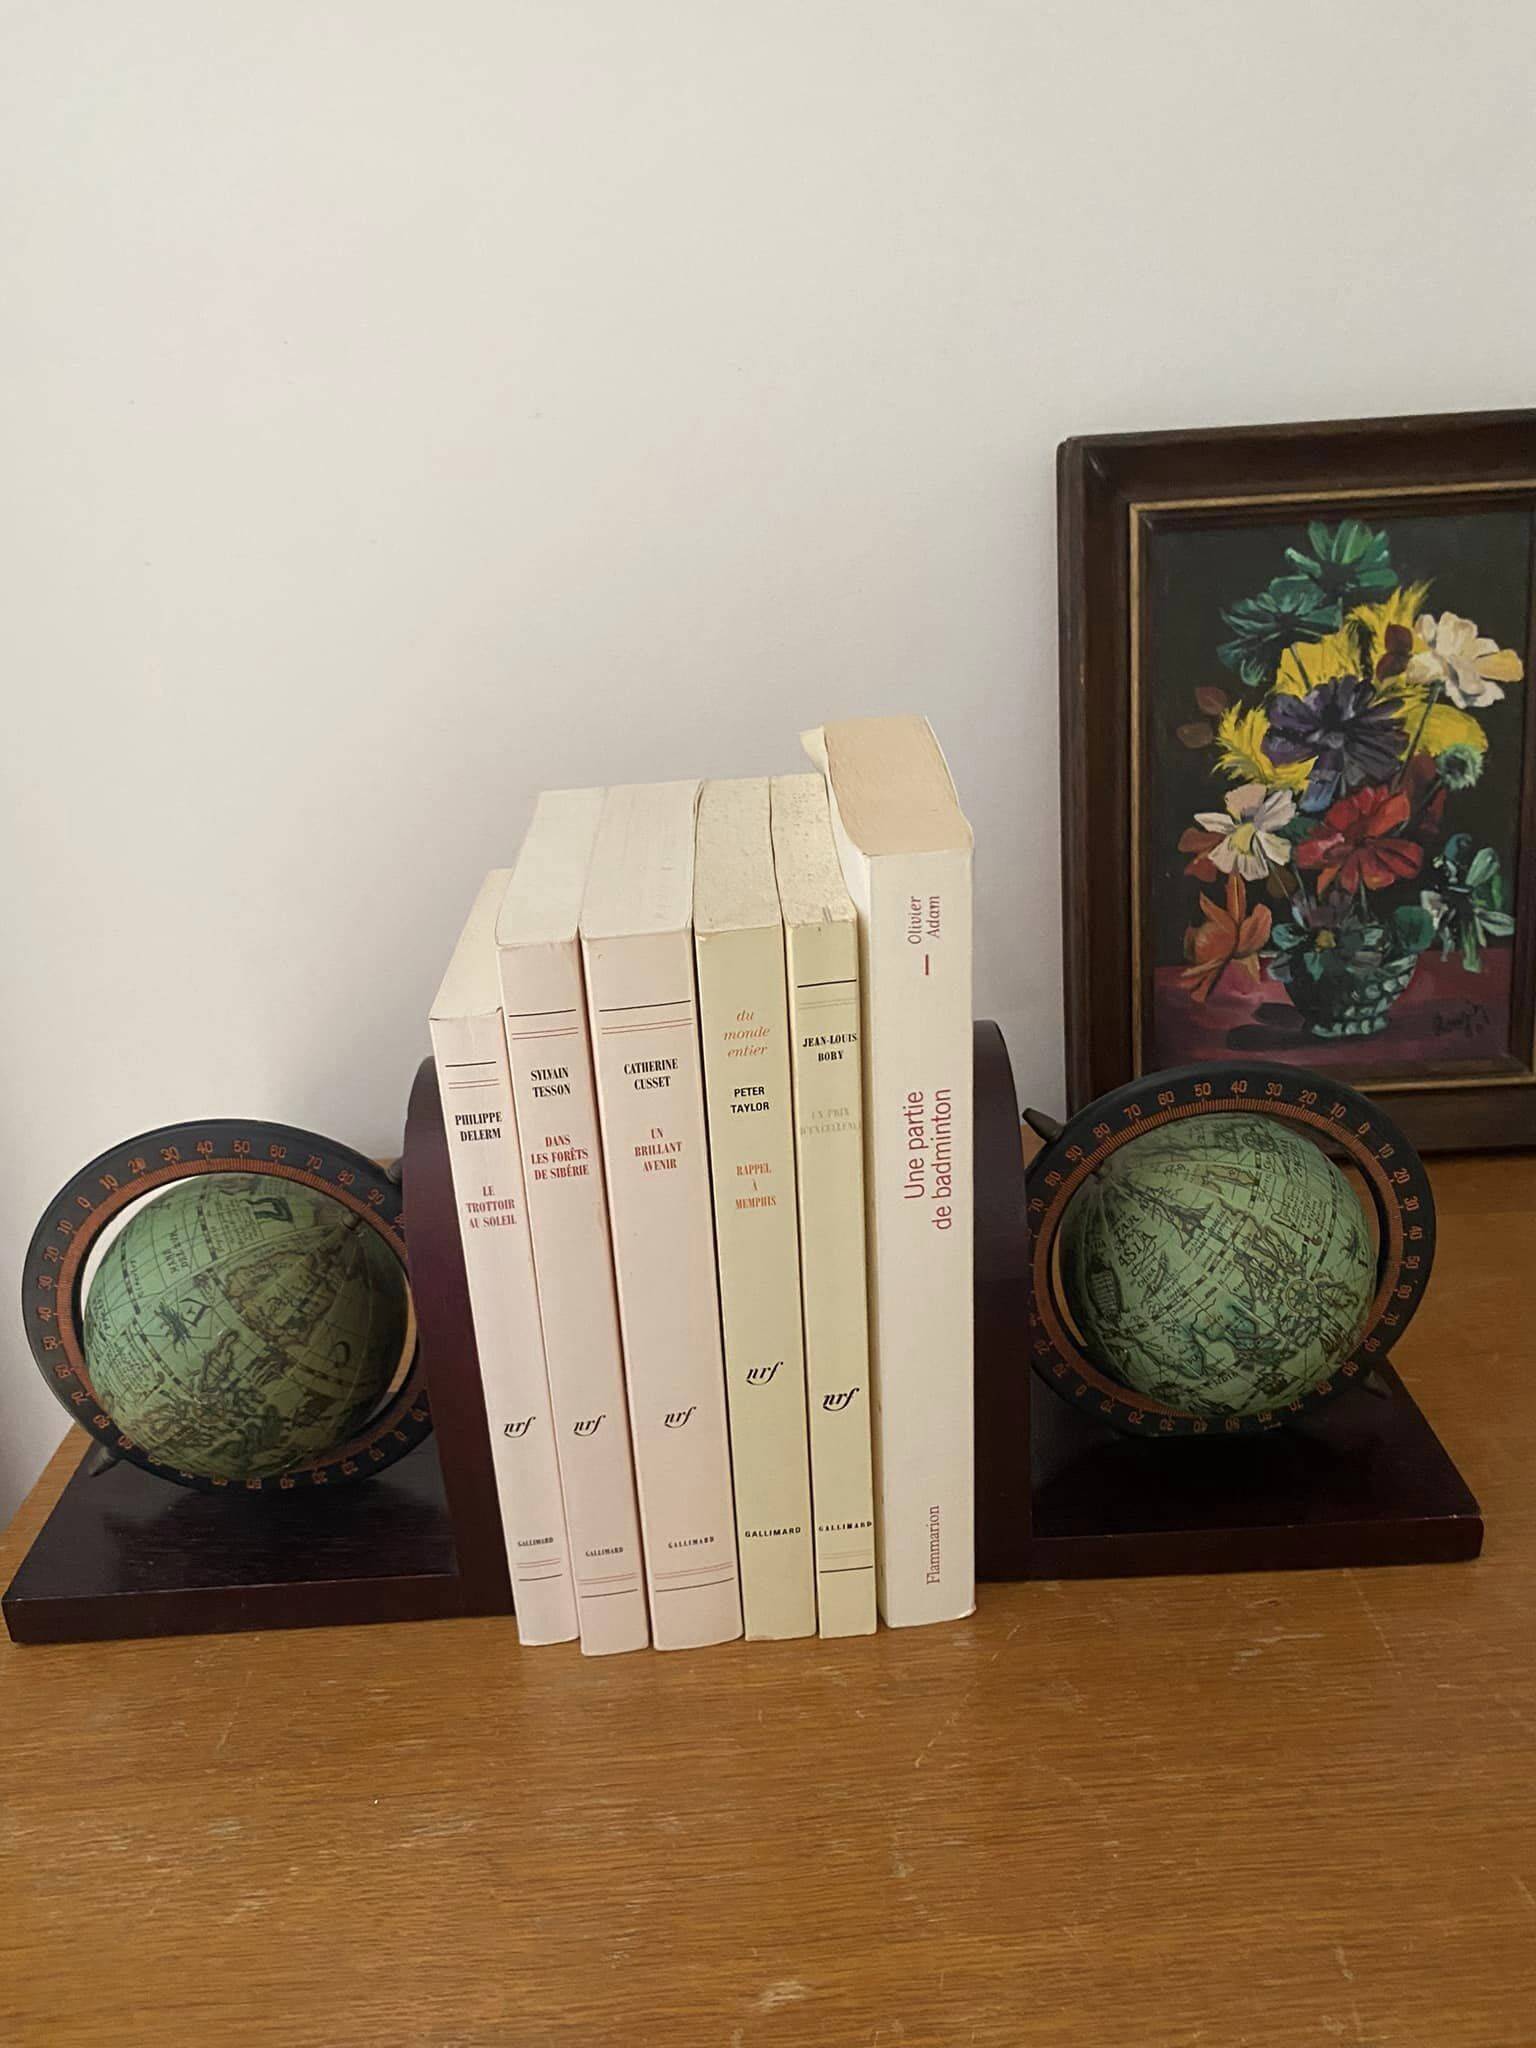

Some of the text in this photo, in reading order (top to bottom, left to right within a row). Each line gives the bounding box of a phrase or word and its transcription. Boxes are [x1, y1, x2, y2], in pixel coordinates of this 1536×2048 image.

[908, 896, 921, 945] Olivier
[926, 896, 940, 938] Adam
[736, 1010, 755, 1022] du
[724, 1028, 770, 1040] monde
[802, 1033, 858, 1048] JEAN-LOUIS
[728, 1045, 768, 1057] entier
[817, 1050, 843, 1062] BORY
[530, 1067, 569, 1081] SYLVAIN
[623, 1058, 679, 1075] CATHERINE
[634, 1076, 671, 1090] CUSSET
[1194, 1082, 1212, 1096] 50
[1230, 1080, 1248, 1094] 40
[1266, 1081, 1283, 1096] 30
[532, 1084, 571, 1098] TESSON
[734, 1087, 765, 1098] PETER
[1158, 1090, 1176, 1105] 60
[1300, 1090, 1318, 1105] 20
[730, 1102, 770, 1114] TAYLOR
[1124, 1103, 1141, 1119] 70
[1331, 1103, 1346, 1119] 10
[455, 1112, 502, 1126] PHILIPPE
[460, 1128, 501, 1142] DELERM
[651, 1128, 663, 1139] UN
[1094, 1122, 1111, 1138] 80
[1359, 1121, 1371, 1135] 0
[196, 1140, 214, 1153] 40
[233, 1140, 250, 1153] 50
[545, 1135, 571, 1147] DANS
[902, 1090, 929, 1200] Une partie
[161, 1147, 179, 1161] 30
[531, 1147, 589, 1165] LES FORÊTS
[634, 1142, 683, 1157] BRILLANT
[1381, 1143, 1396, 1159] 10
[127, 1158, 146, 1173] 20
[305, 1156, 323, 1170] 70
[643, 1159, 677, 1172] AVENIR
[931, 1089, 952, 1229] de badminton
[534, 1163, 590, 1180] DE SIBÉRIE
[736, 1163, 771, 1176] RAPPEL
[1393, 1169, 1409, 1185] 20
[99, 1174, 118, 1191] 10
[483, 1186, 495, 1196] LE
[78, 1196, 91, 1209] 0
[466, 1199, 515, 1214] TROTTOIR
[735, 1195, 777, 1210] MEMPHIS
[1404, 1196, 1420, 1212] 30
[56, 1219, 73, 1234] 10
[469, 1214, 517, 1228] AU SOLEIL
[1408, 1225, 1423, 1241] 40
[44, 1246, 62, 1263] 20
[1118, 1231, 1158, 1267] ASIA
[1406, 1255, 1421, 1270] 50
[38, 1274, 53, 1288] 30
[37, 1306, 53, 1322] 40
[43, 1334, 60, 1352] 50
[746, 1362, 783, 1387] nrf
[822, 1387, 860, 1412] nrf
[664, 1406, 696, 1429] nrf
[503, 1415, 537, 1439] nrf
[573, 1414, 606, 1437] nrf
[744, 1526, 801, 1538] GALLIMARD
[818, 1520, 872, 1533] GALLIMARD
[517, 1537, 554, 1548] GALLIMARD
[668, 1536, 714, 1549] GALLIMARD
[925, 1505, 940, 1586] Flammarion
[585, 1546, 624, 1557] GALLIMARD
